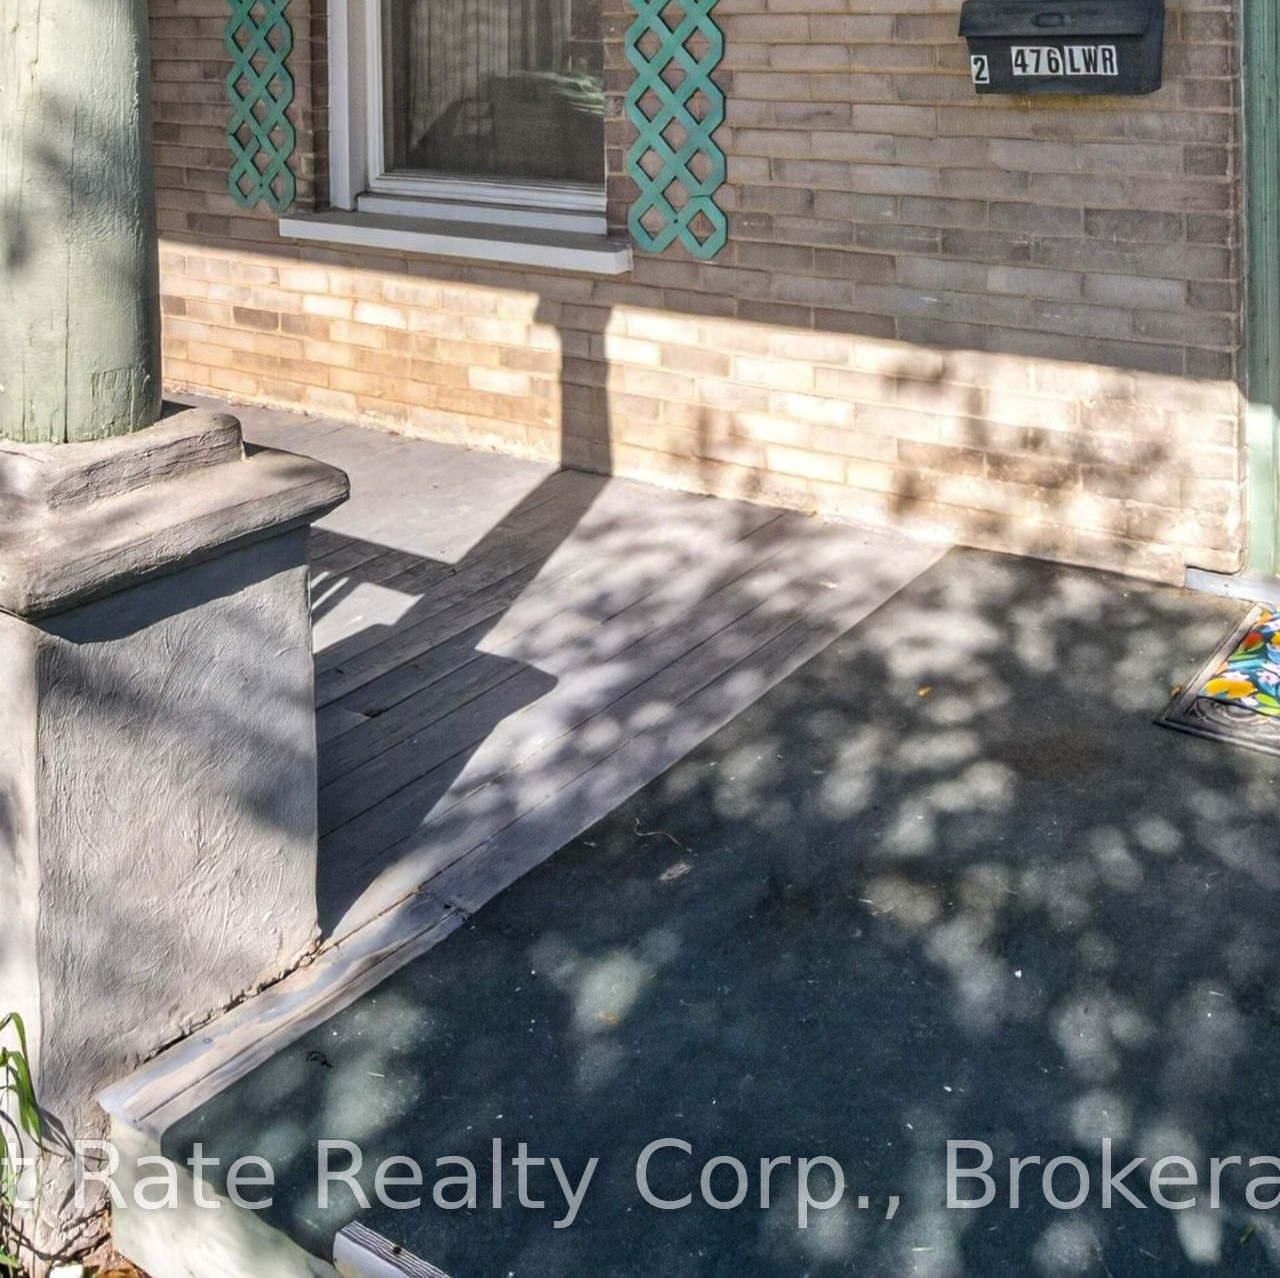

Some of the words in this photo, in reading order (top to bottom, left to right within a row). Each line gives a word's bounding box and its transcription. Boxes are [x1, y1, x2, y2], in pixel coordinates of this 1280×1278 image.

[973, 56, 988, 82] 2
[1014, 48, 1061, 74] 476
[1068, 47, 1115, 74] LWR
